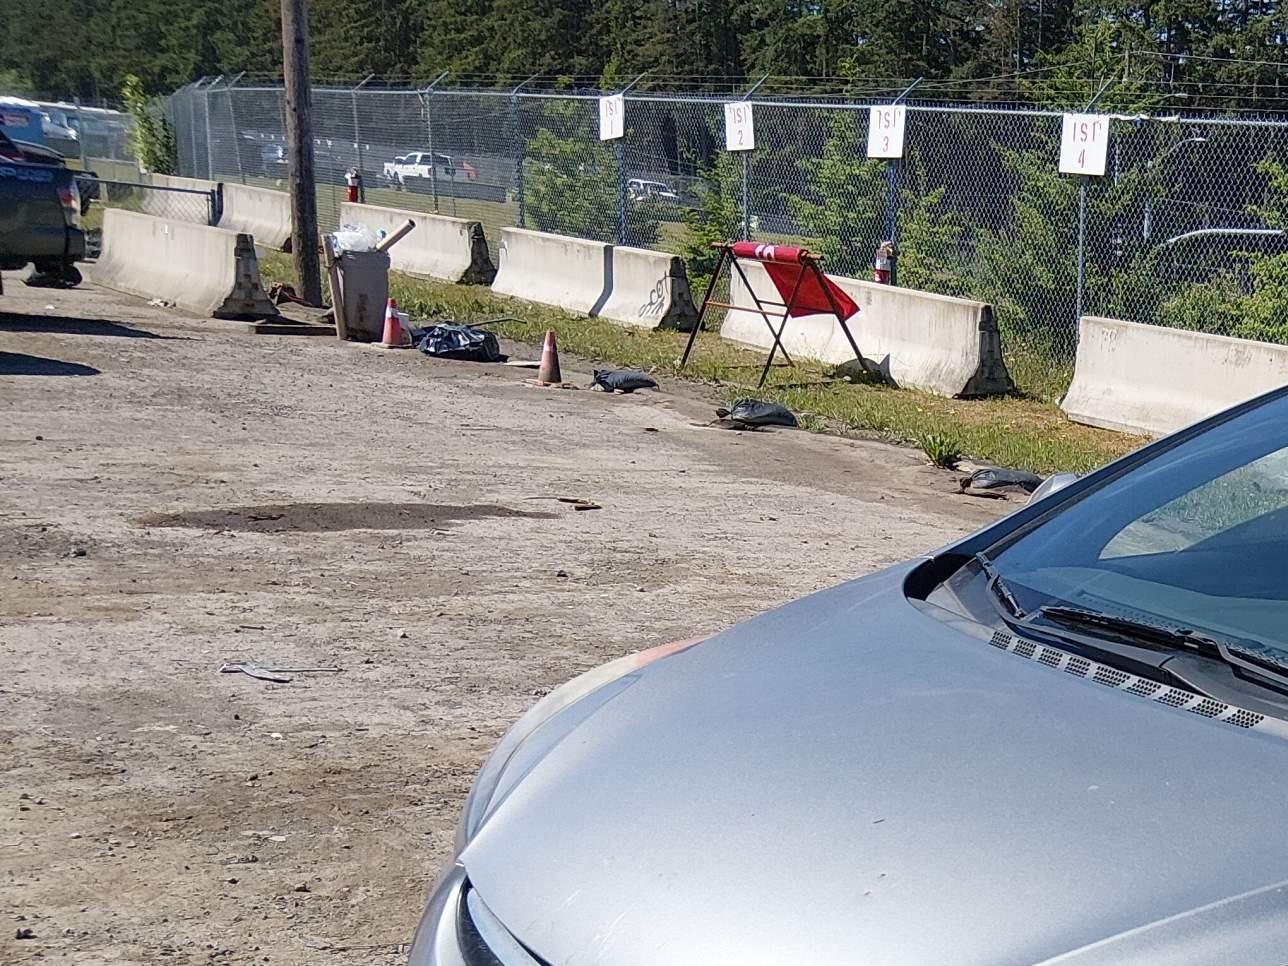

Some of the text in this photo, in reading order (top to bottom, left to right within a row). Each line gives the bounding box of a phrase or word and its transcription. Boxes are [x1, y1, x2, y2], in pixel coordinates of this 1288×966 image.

[737, 129, 744, 146] 2
[882, 135, 889, 153] 3
[1077, 148, 1085, 169] 4
